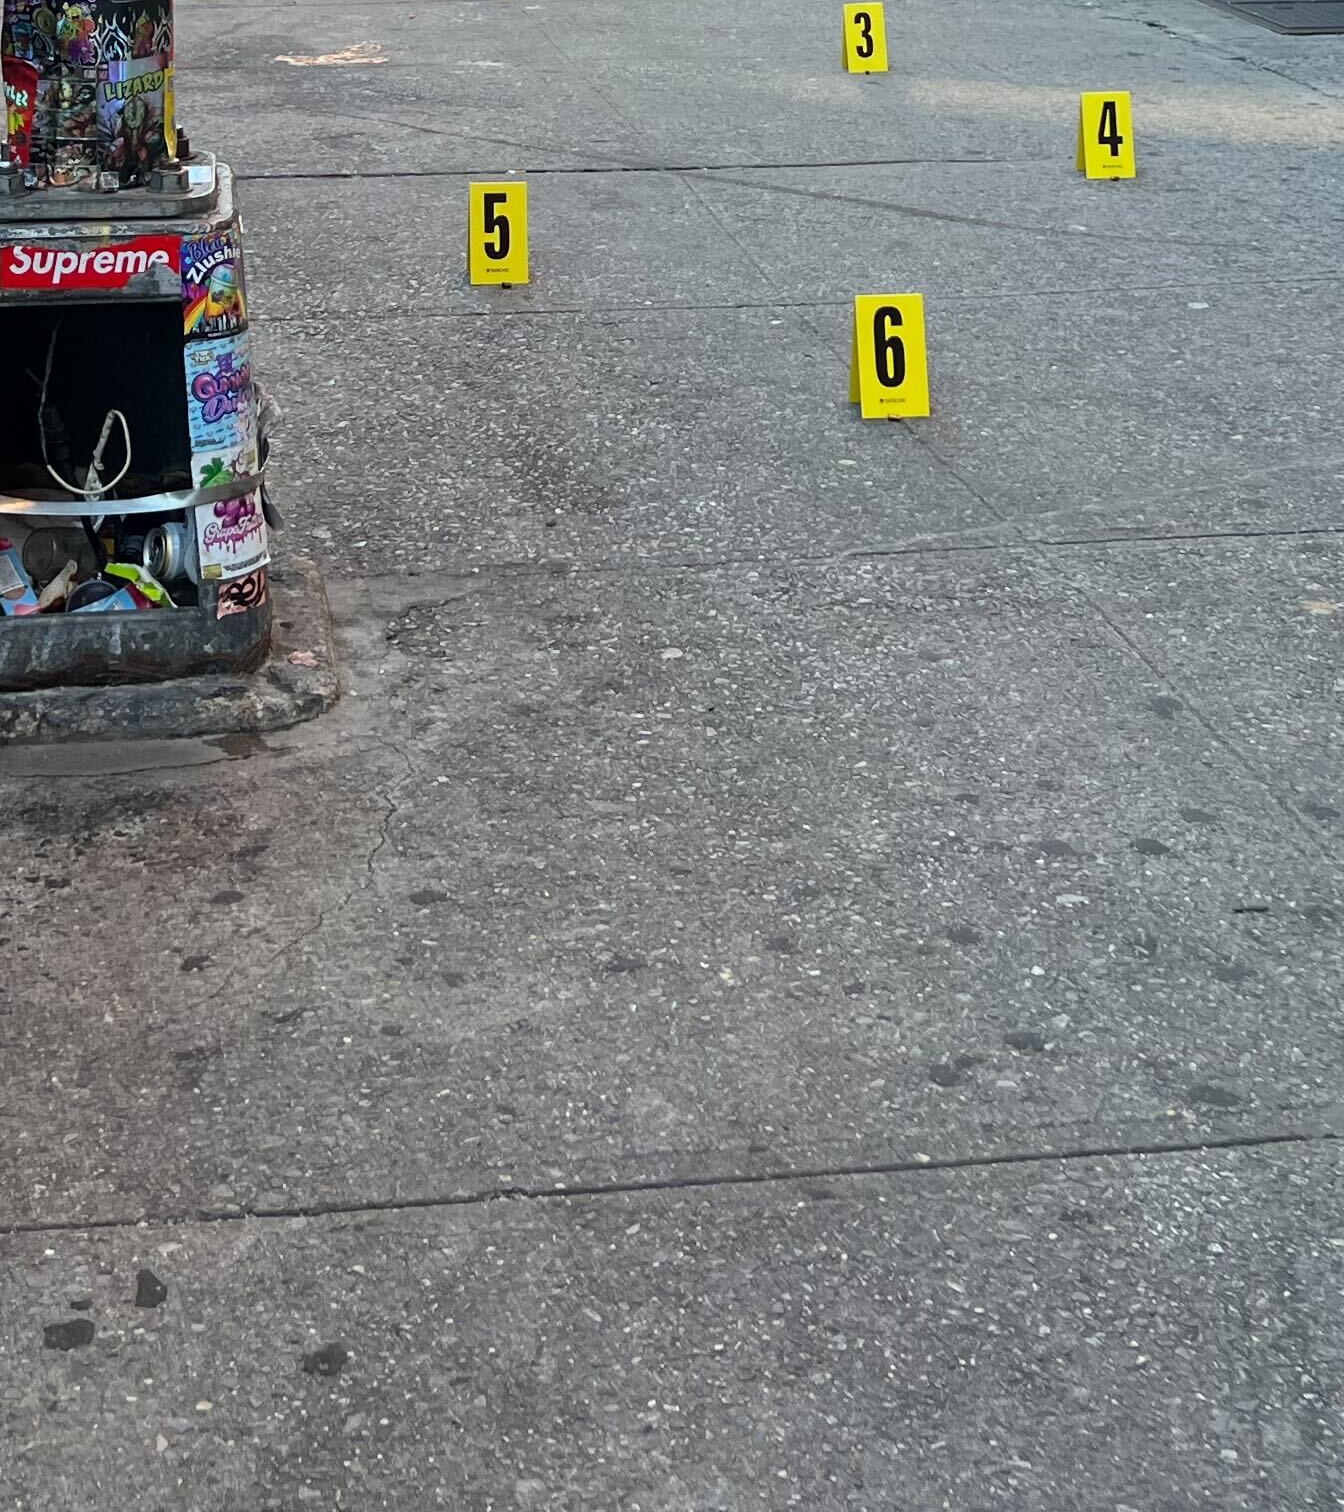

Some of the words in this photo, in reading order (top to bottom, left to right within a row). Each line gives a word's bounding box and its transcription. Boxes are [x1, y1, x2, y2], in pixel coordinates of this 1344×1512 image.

[854, 11, 874, 58] 3
[103, 69, 165, 102] LIZARD
[1097, 100, 1123, 157] 4
[483, 192, 510, 260] 5
[9, 245, 169, 284] Supreme
[186, 243, 241, 284] Zlushie
[873, 305, 906, 388] 6
